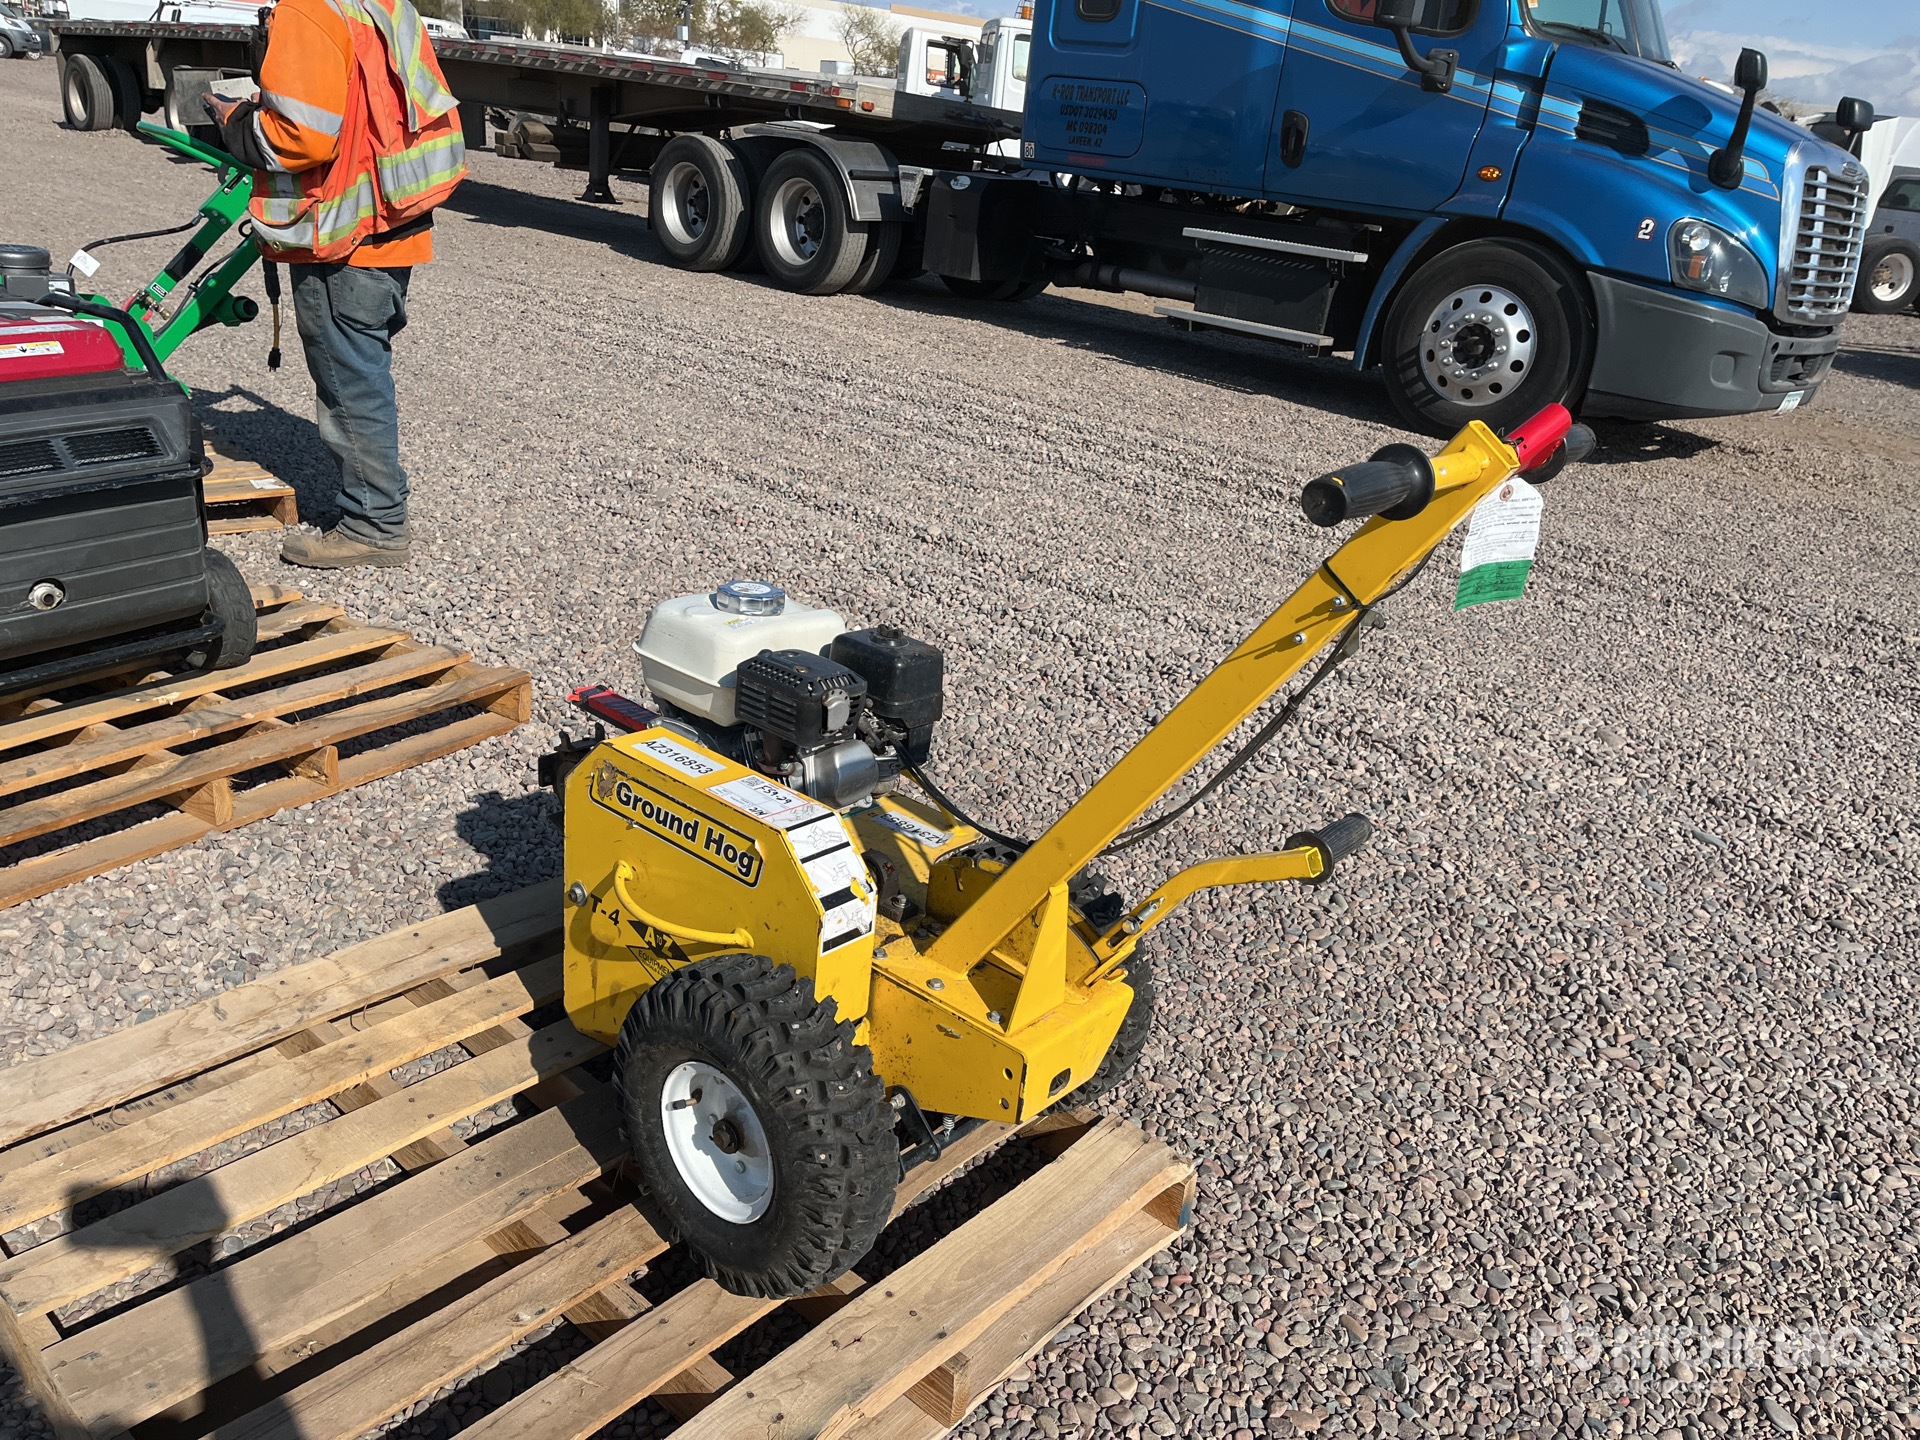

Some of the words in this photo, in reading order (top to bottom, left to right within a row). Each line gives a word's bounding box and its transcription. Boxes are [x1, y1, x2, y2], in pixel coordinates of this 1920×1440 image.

[1076, 85, 1117, 105] TRANSPORT
[1117, 88, 1131, 106] LLC
[1060, 105, 1084, 116] USDOT
[1084, 106, 1118, 121] 3029450
[1065, 120, 1078, 133] MC
[1025, 146, 1034, 158] 80
[1637, 217, 1656, 240] 2
[641, 740, 714, 775] AZ316853
[615, 781, 699, 844] Ground
[703, 826, 755, 878] Hog
[880, 813, 949, 845] AZ316853
[590, 893, 620, 926] T-4
